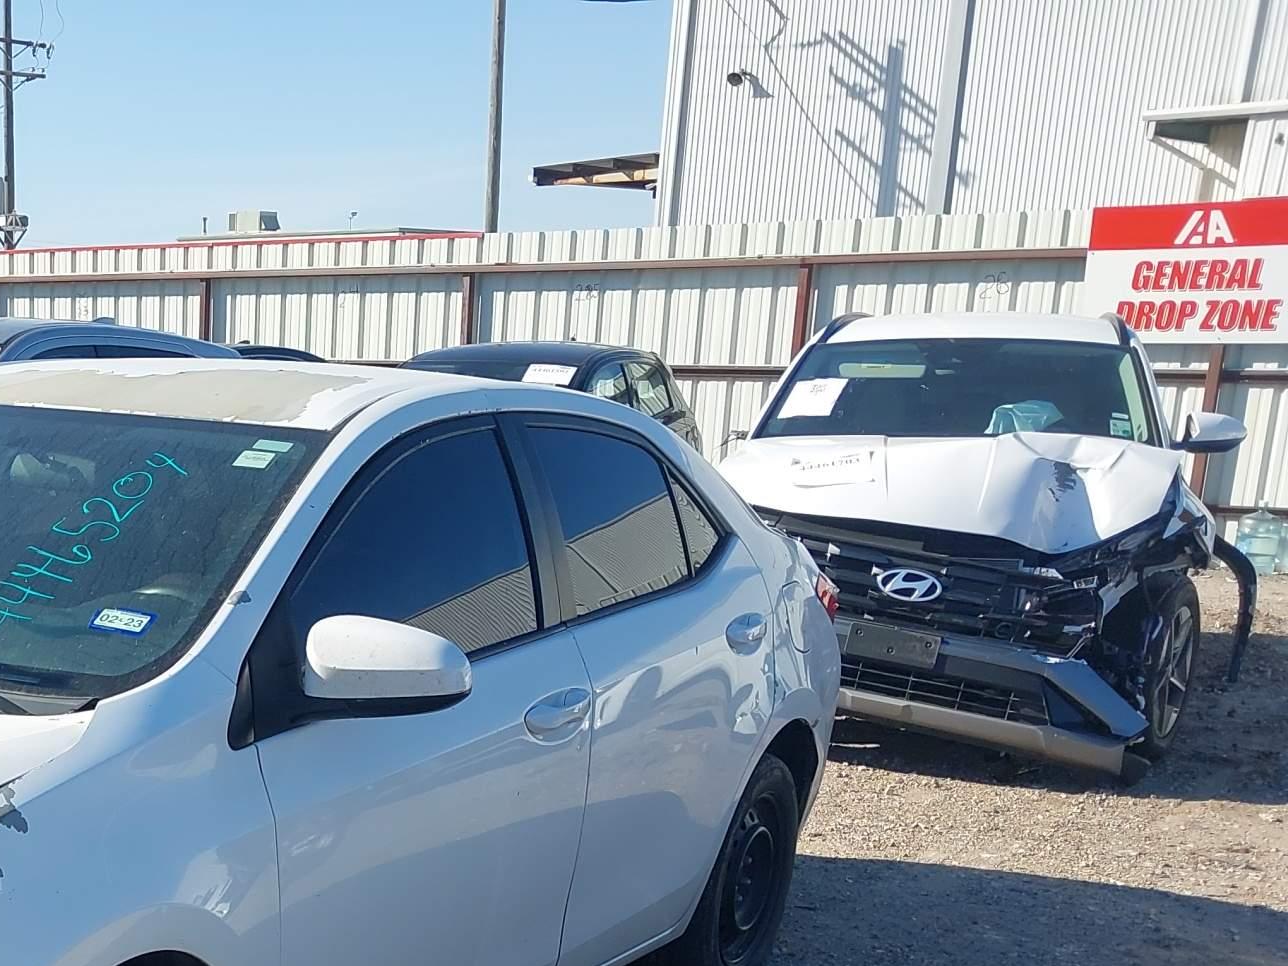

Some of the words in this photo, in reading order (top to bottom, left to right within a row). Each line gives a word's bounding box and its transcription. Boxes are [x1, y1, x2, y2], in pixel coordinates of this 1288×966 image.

[1131, 258, 1265, 293] GENERAL
[1116, 299, 1199, 333] DROP
[1199, 298, 1284, 332] ZONE
